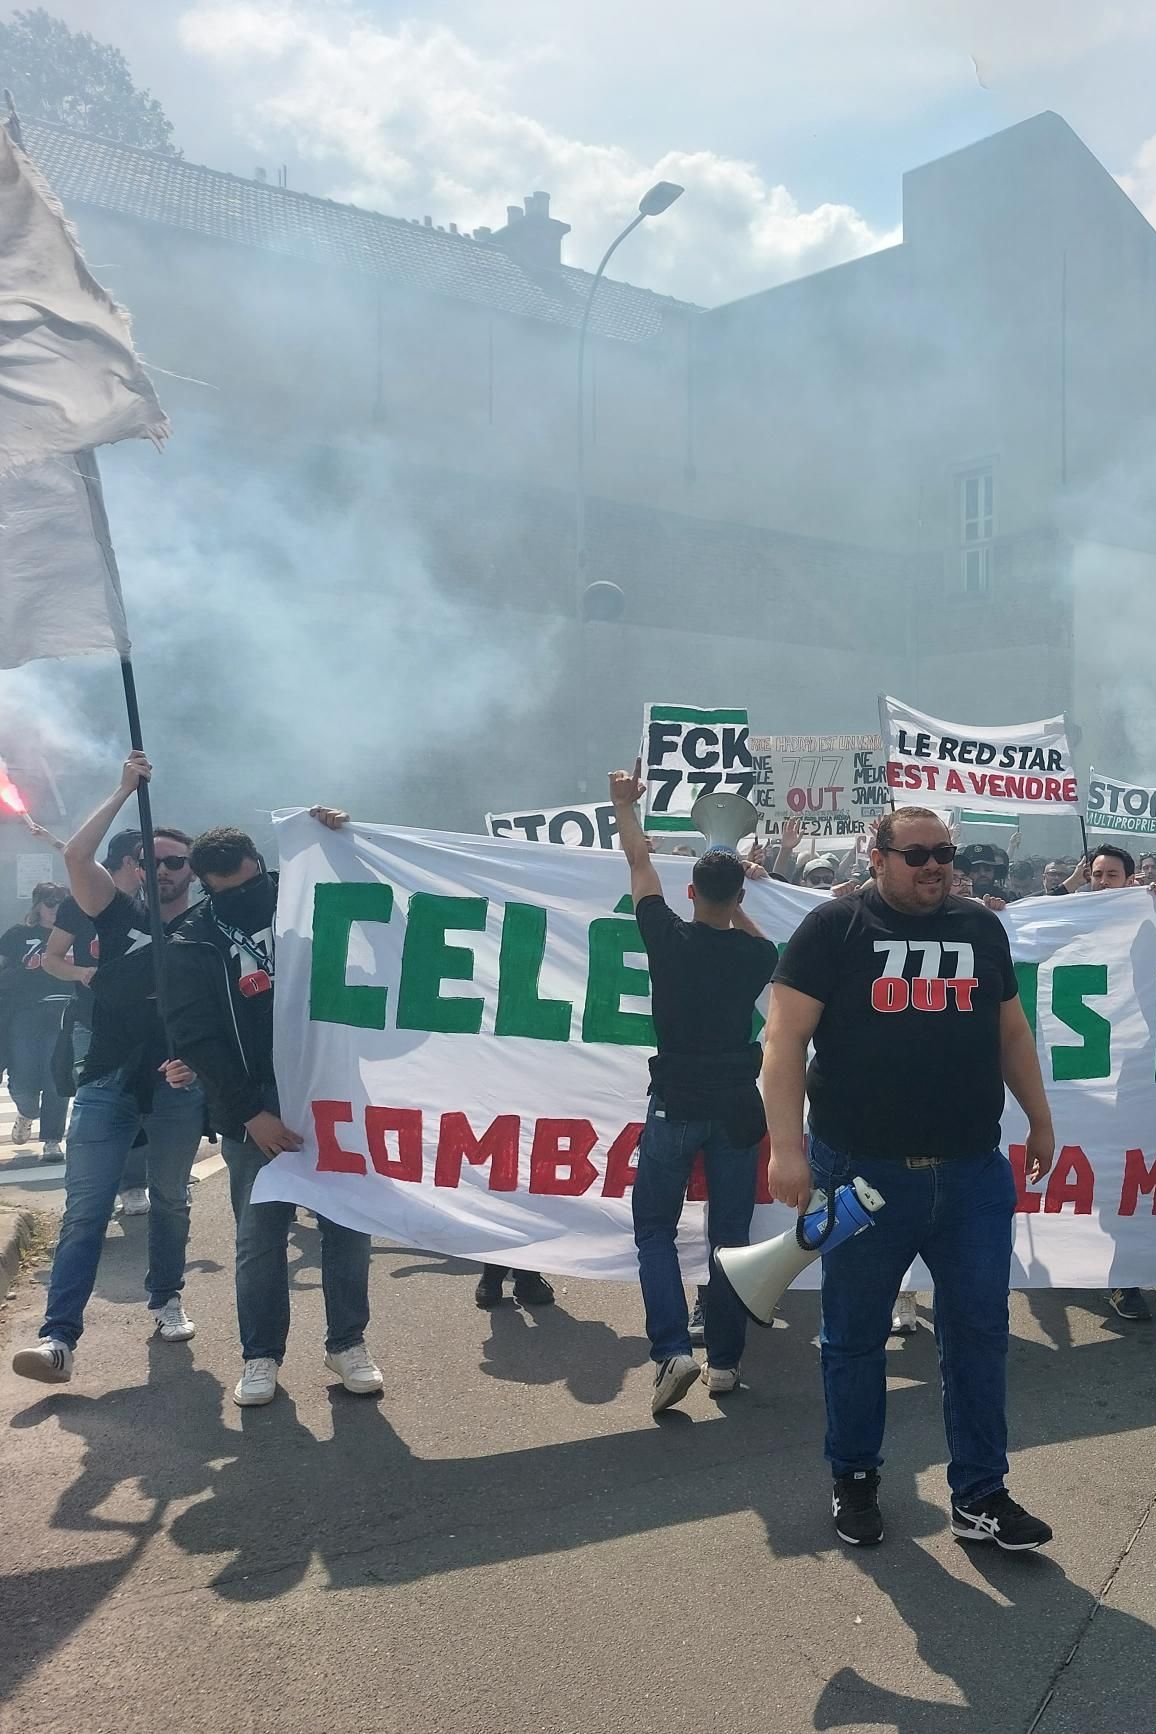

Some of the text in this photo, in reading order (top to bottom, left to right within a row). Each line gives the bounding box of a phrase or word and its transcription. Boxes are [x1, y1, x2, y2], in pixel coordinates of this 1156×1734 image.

[647, 722, 752, 769] FCK
[854, 752, 873, 768] NE
[899, 730, 1065, 772] LE RED STAR
[782, 756, 843, 787] 777
[886, 761, 1079, 802] EST A VENDRE
[786, 787, 844, 812] OUT
[873, 940, 975, 979] 777
[871, 976, 979, 1013] OUT
[1009, 1143, 1095, 1216] LA
